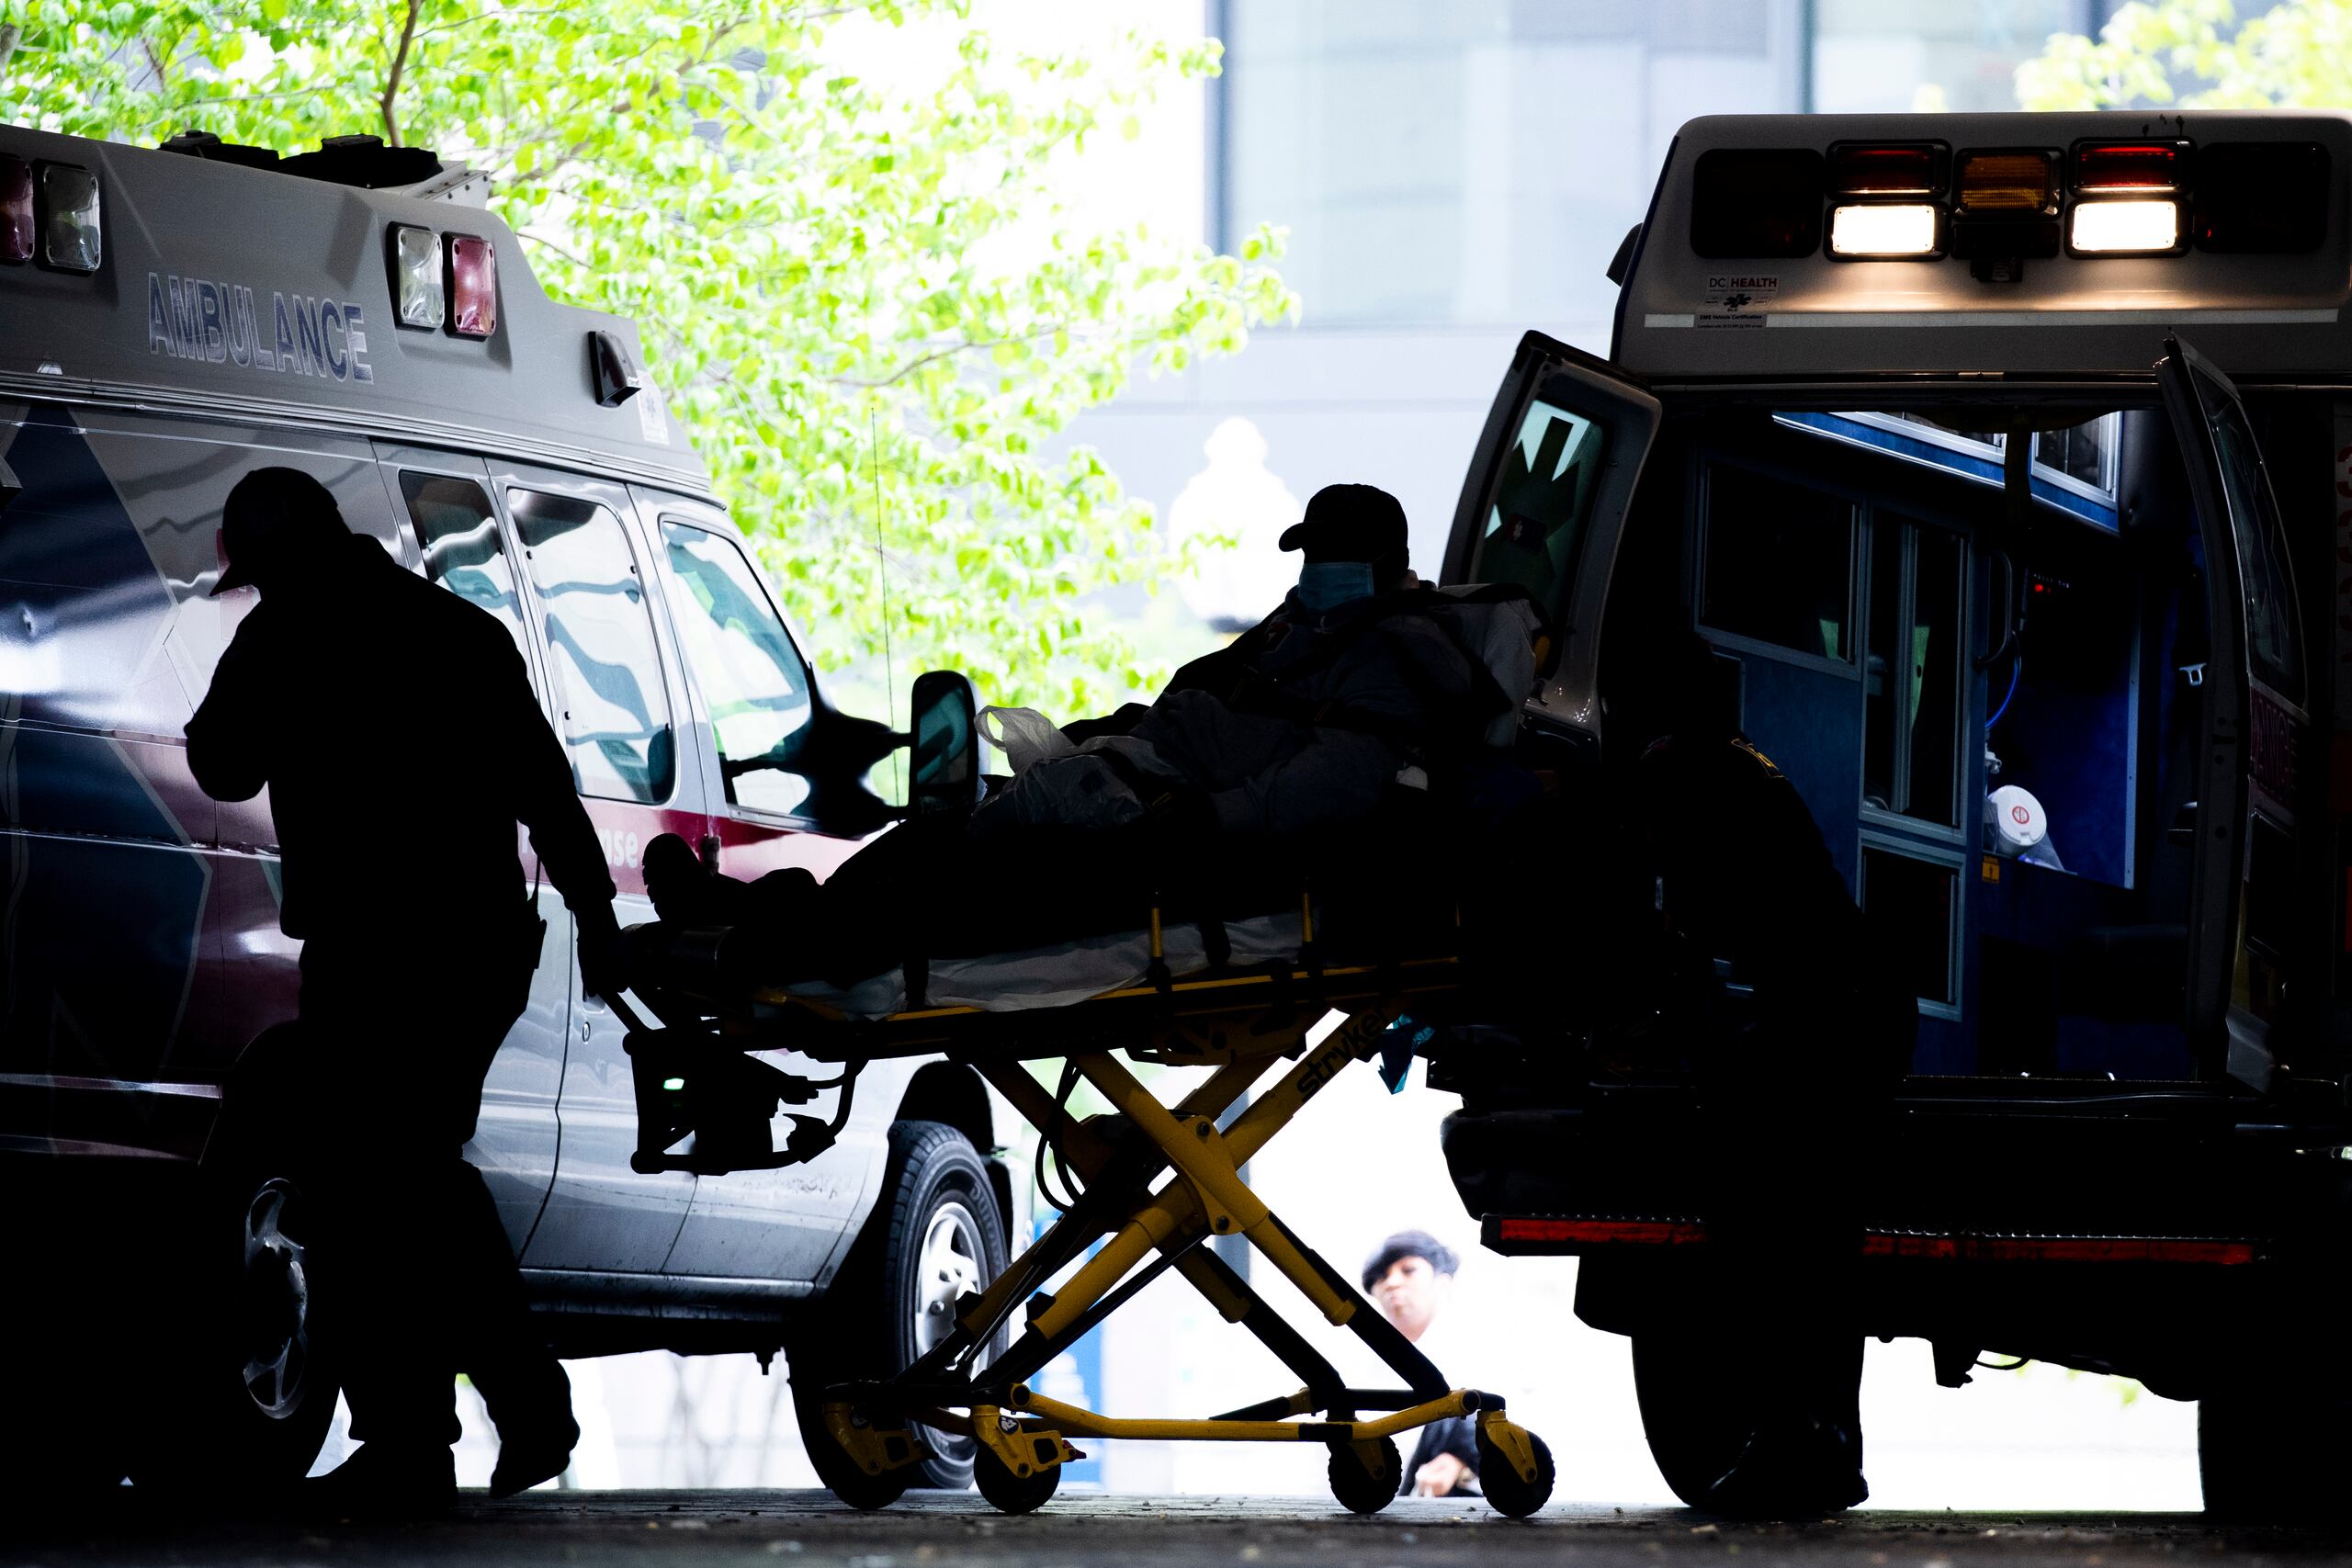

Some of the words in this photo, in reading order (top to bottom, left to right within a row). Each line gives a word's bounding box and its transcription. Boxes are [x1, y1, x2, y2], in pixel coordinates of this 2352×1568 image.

[1709, 277, 1726, 288] DC
[1731, 277, 1777, 288] HEALTH
[148, 272, 375, 385] AMBULANCE
